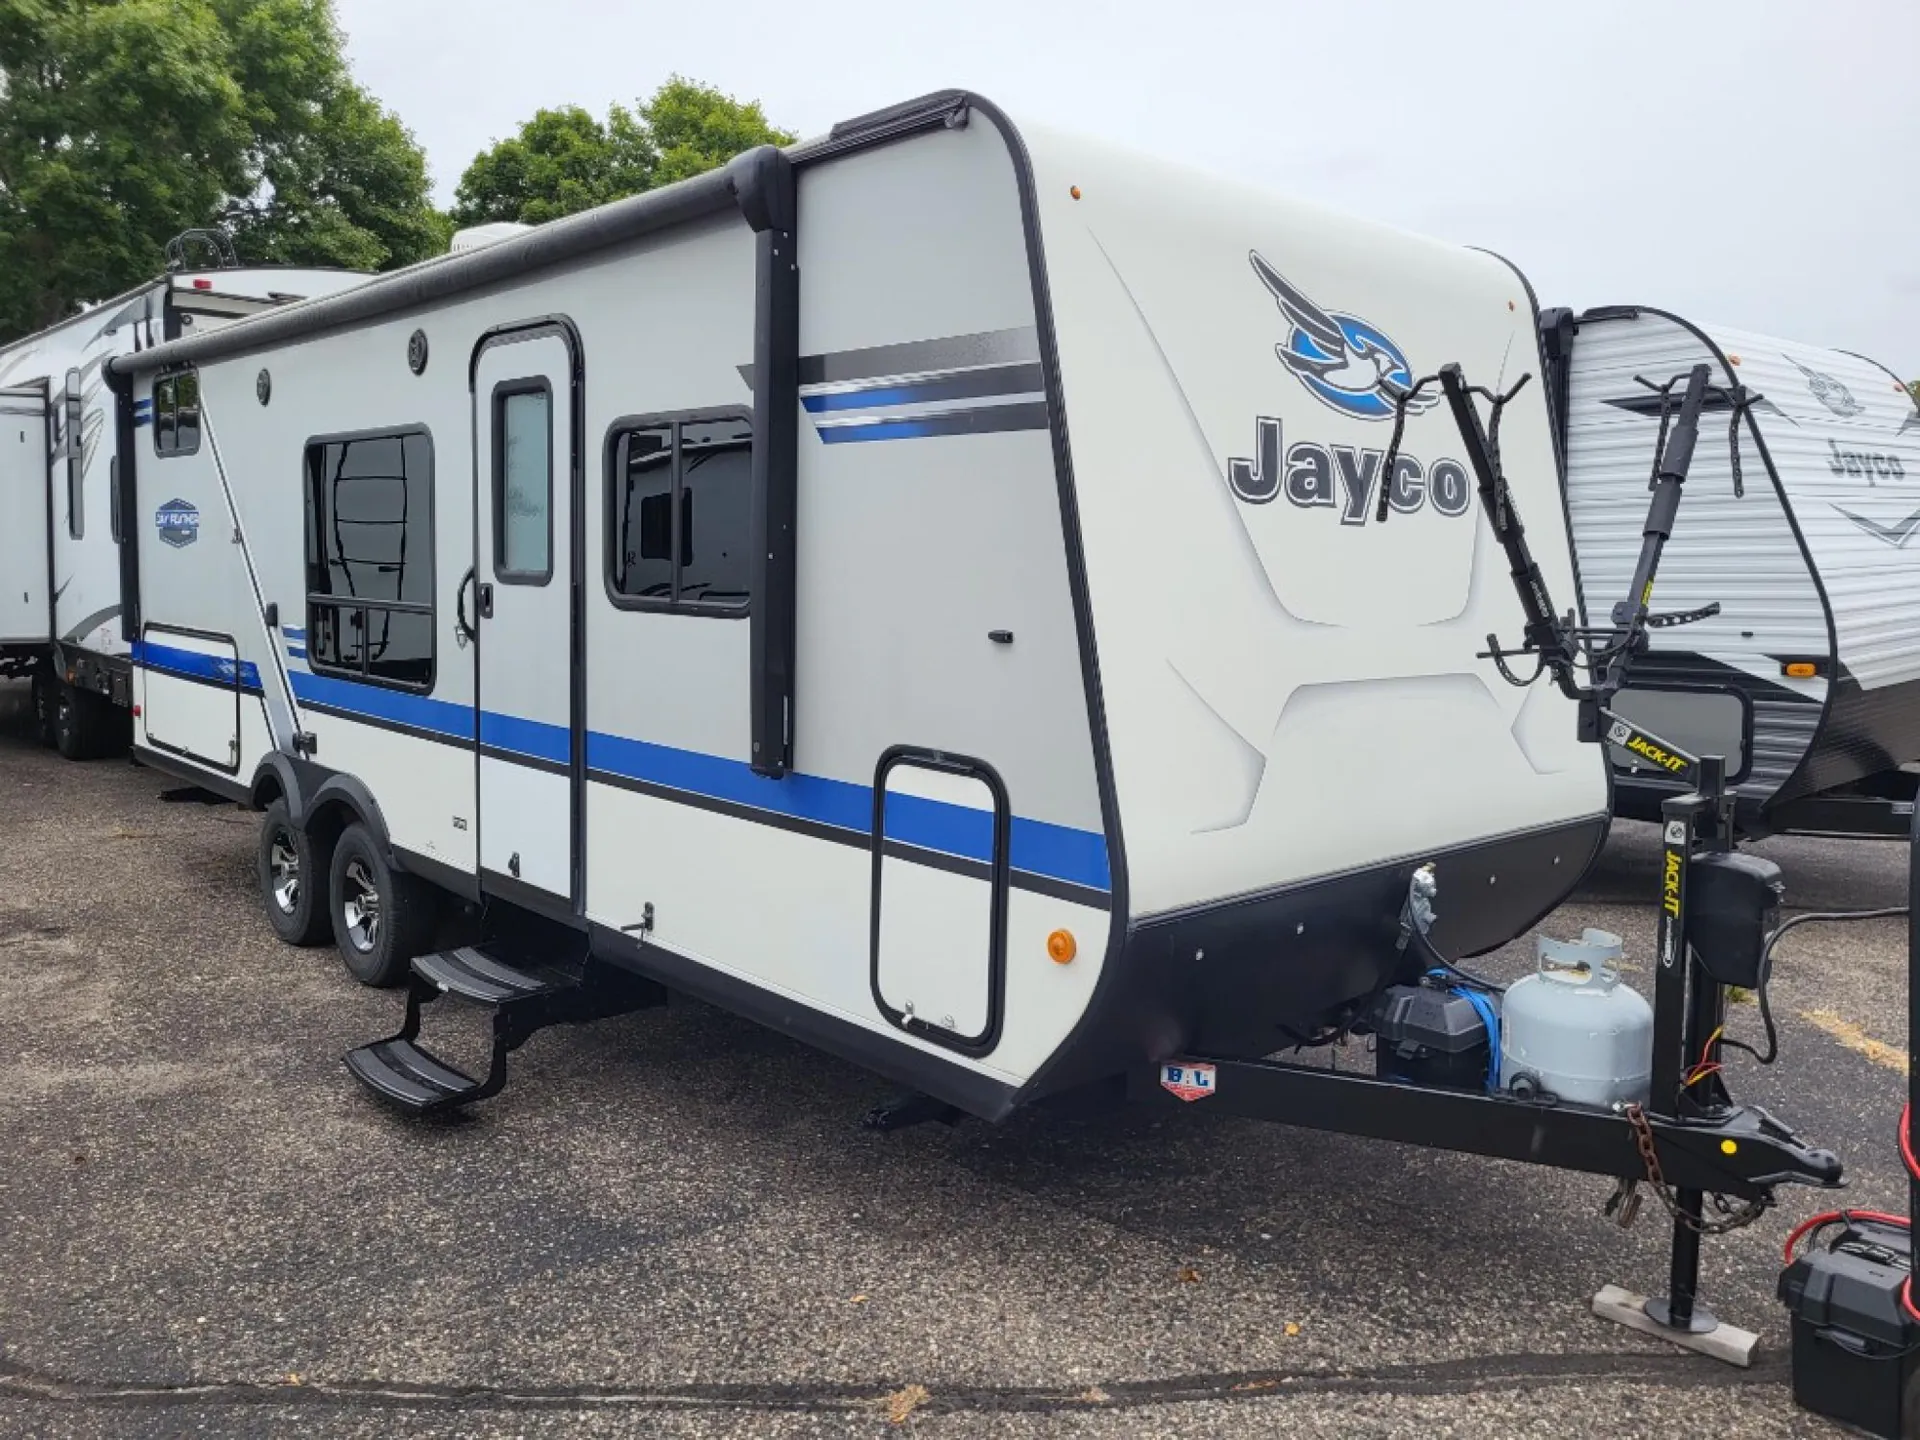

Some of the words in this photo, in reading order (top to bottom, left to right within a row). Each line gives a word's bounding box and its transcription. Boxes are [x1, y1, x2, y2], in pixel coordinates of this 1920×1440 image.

[1228, 416, 1470, 526] Jayco
[1828, 438, 1905, 487] Jayco
[1627, 737, 1688, 771] JACK-IT
[1664, 850, 1682, 919] JACK-IT
